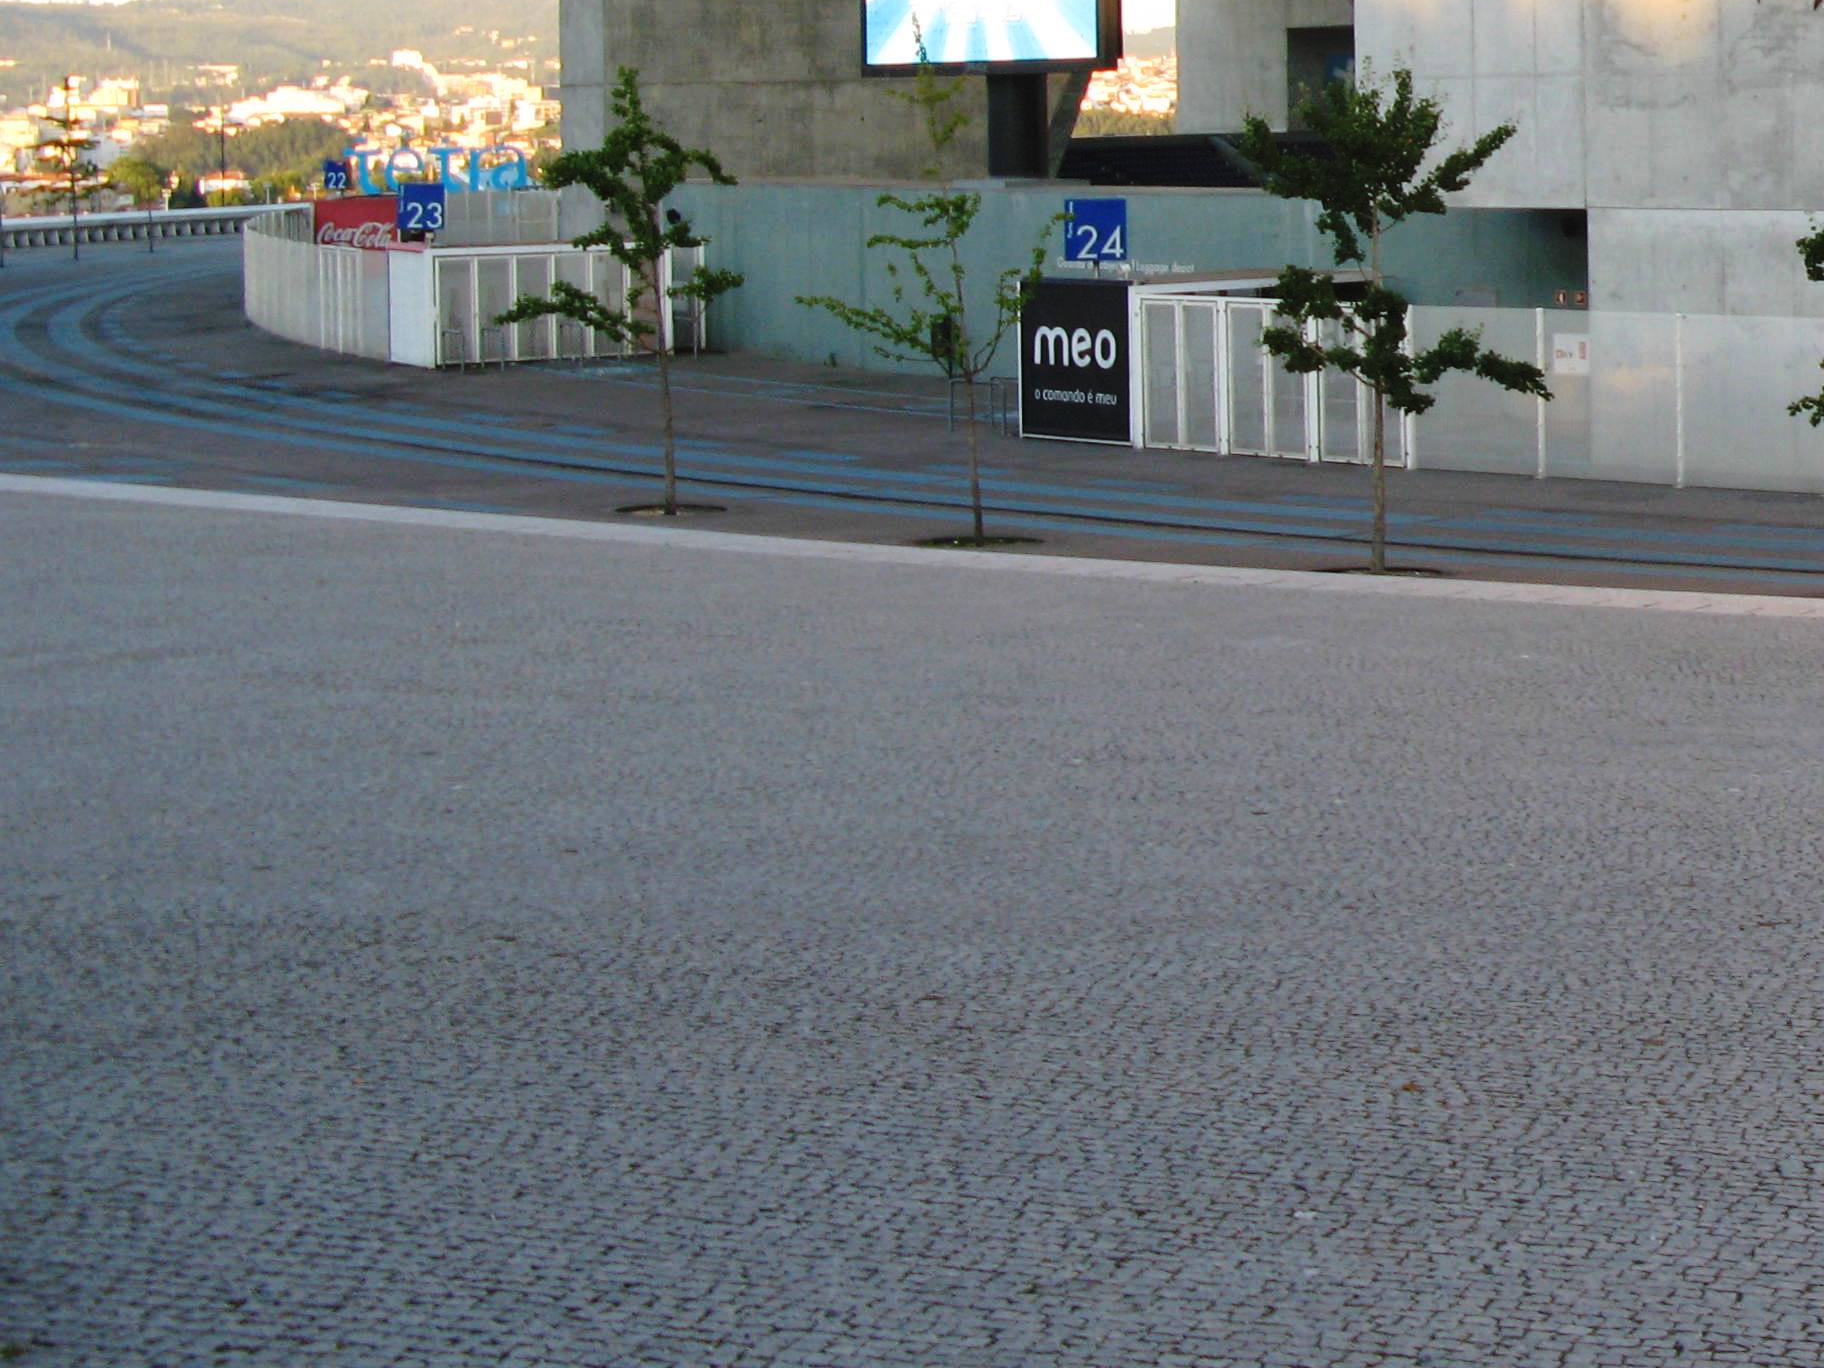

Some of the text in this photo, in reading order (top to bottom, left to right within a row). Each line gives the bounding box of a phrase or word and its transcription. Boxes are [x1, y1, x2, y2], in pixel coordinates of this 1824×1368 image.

[327, 172, 346, 189] 22
[406, 202, 443, 229] 23
[1076, 224, 1125, 259] 24
[1034, 325, 1117, 370] meo
[1034, 388, 1041, 399] o
[1042, 388, 1086, 403] comando
[1095, 392, 1118, 406] meu
